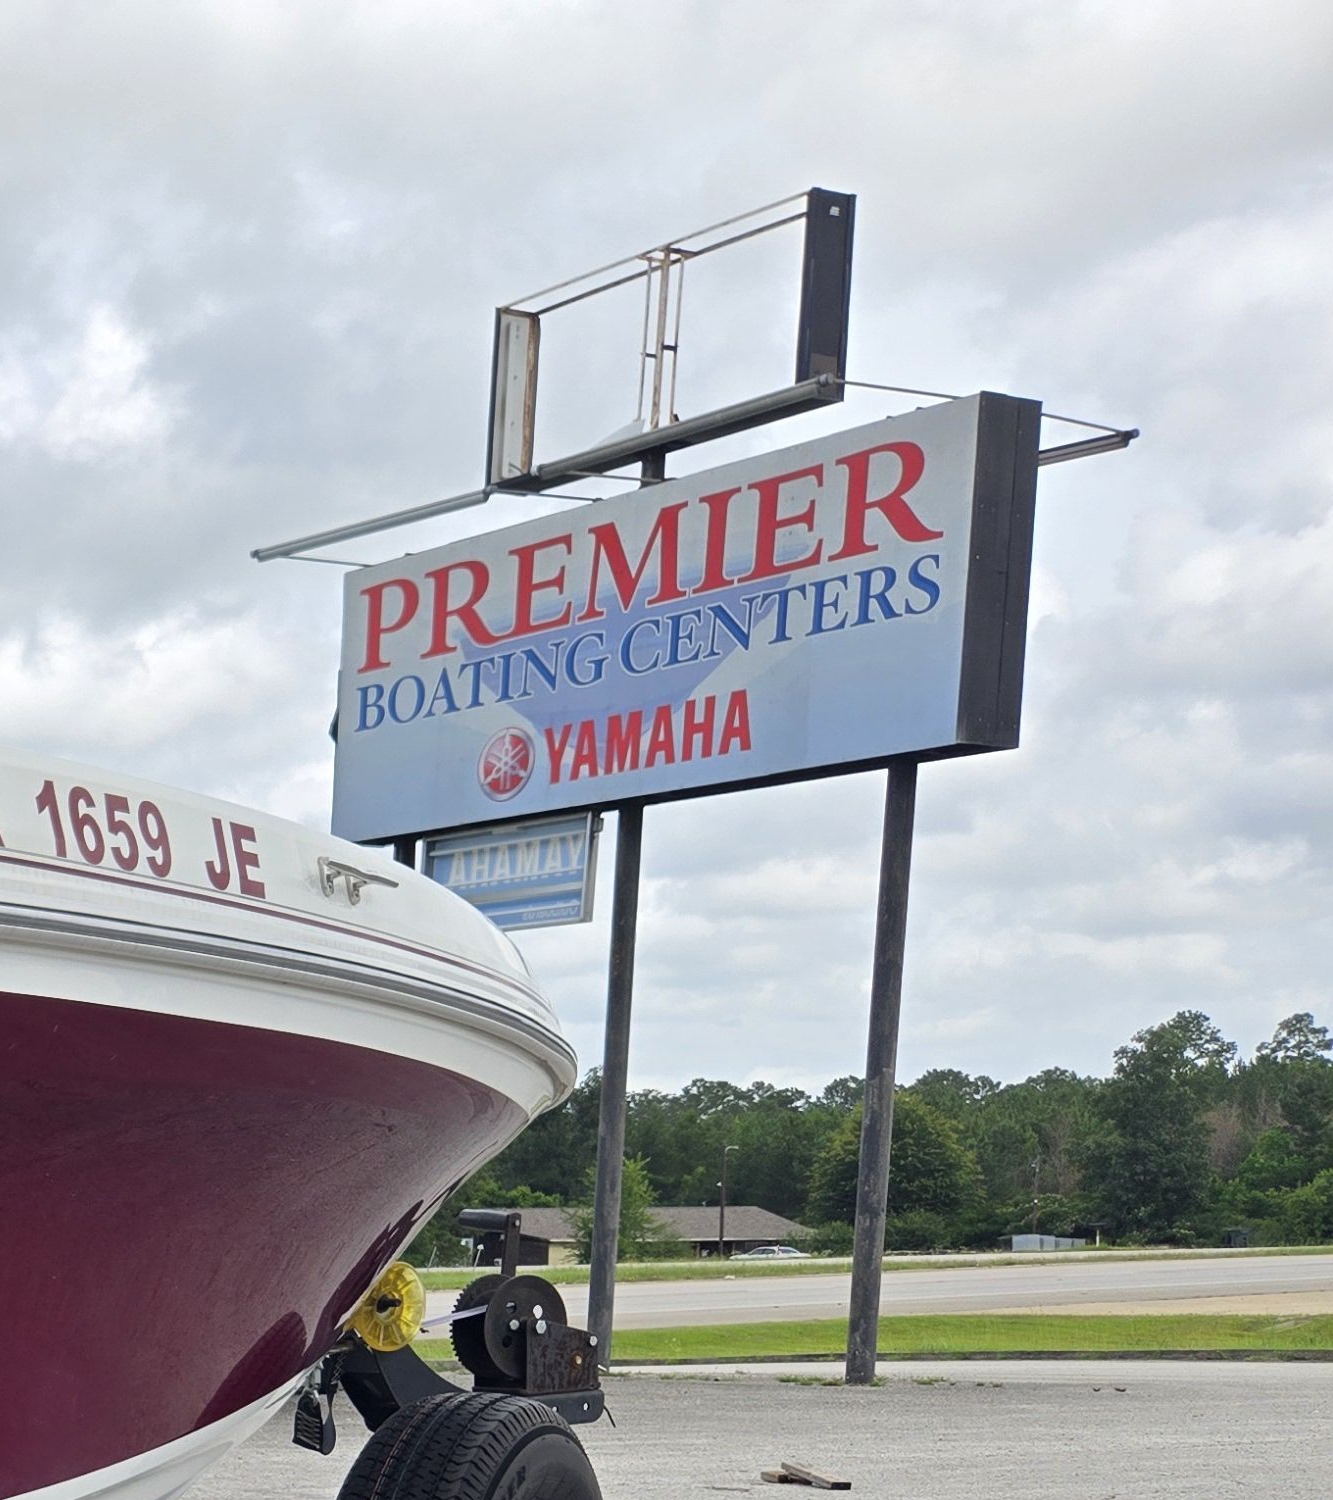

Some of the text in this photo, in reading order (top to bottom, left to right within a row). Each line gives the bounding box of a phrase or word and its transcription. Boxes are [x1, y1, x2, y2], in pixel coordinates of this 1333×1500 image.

[357, 441, 944, 674] PREMIER
[354, 554, 941, 733] BOATING CENTERS
[543, 688, 752, 785] YAMAHA
[35, 779, 172, 878] 1659
[204, 817, 266, 899] JE
